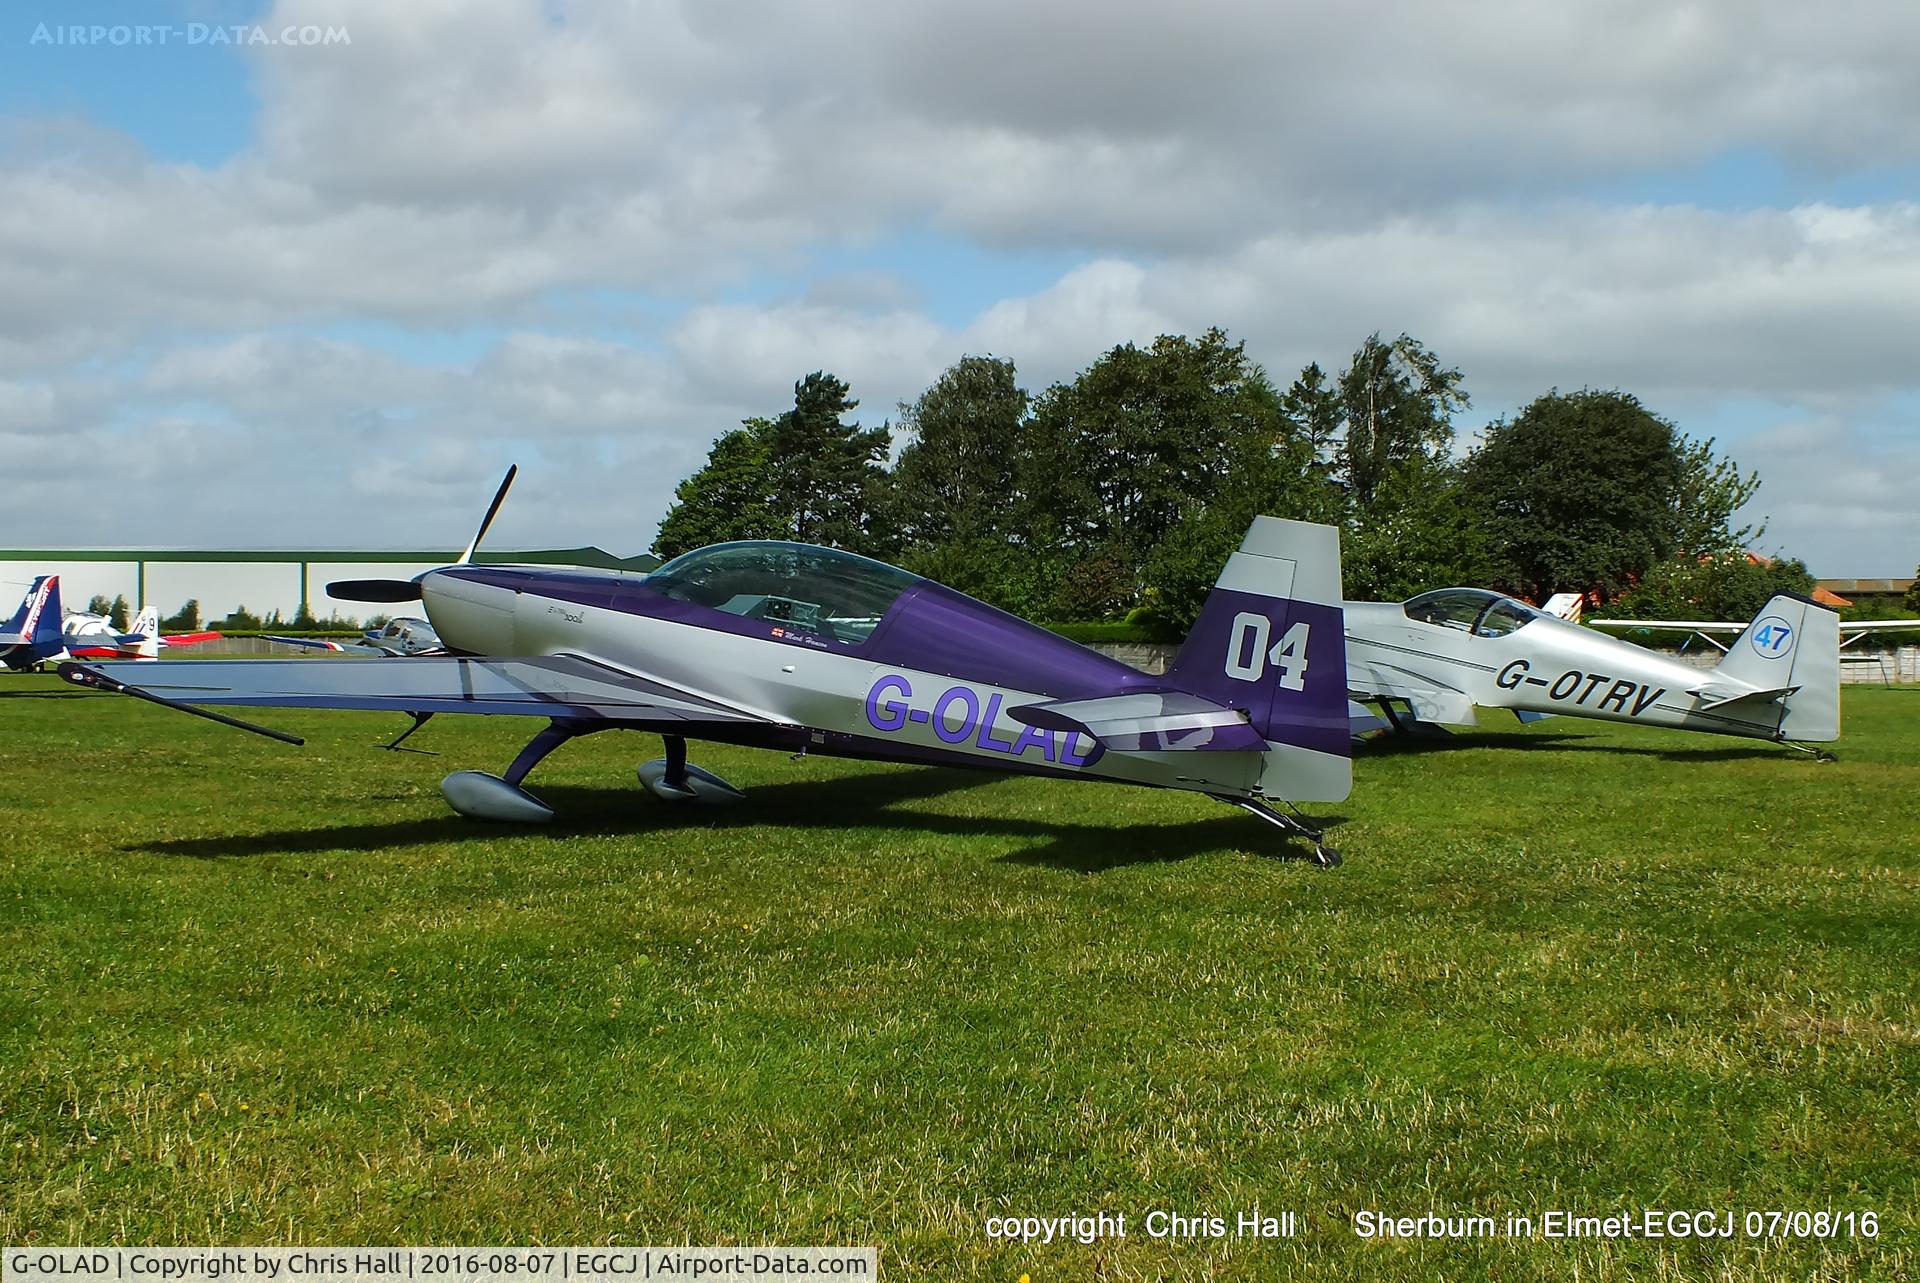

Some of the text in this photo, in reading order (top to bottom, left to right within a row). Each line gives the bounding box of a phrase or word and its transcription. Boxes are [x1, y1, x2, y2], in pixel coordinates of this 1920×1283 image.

[149, 617, 156, 631] 9
[1754, 624, 1790, 651] 47
[1224, 611, 1310, 692] 04
[1496, 659, 1666, 717] G-OTRV
